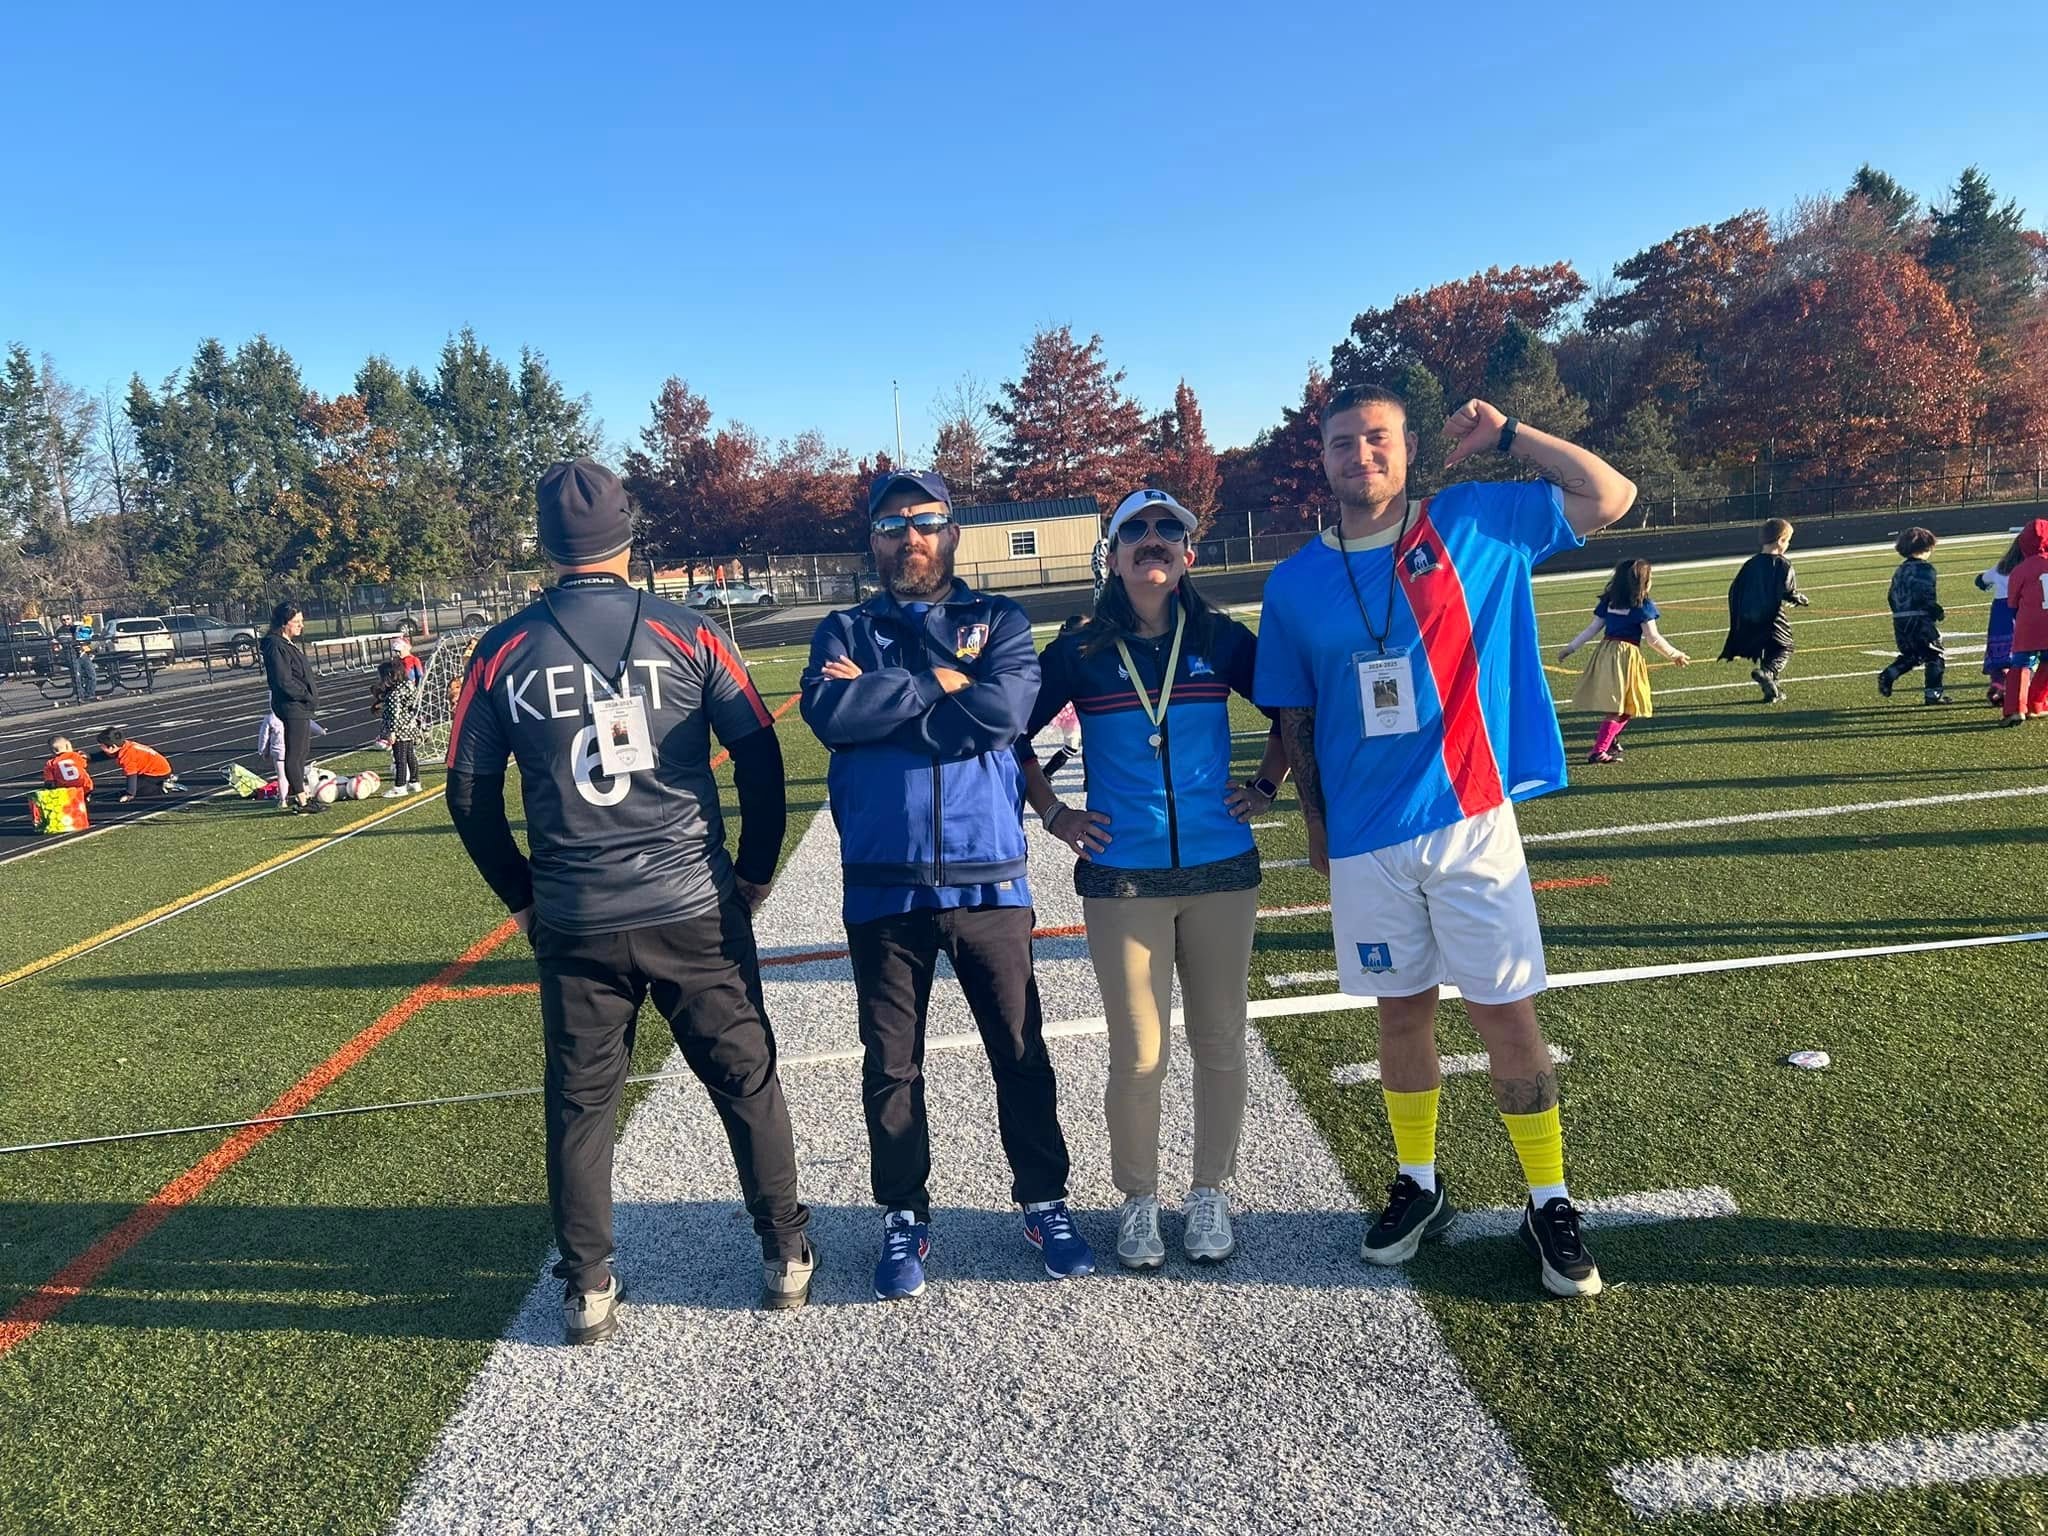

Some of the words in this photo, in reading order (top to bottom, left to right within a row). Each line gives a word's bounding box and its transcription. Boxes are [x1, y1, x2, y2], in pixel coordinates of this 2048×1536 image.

[506, 660, 671, 723] KENT
[58, 759, 80, 780] 6
[571, 725, 631, 806] 6
